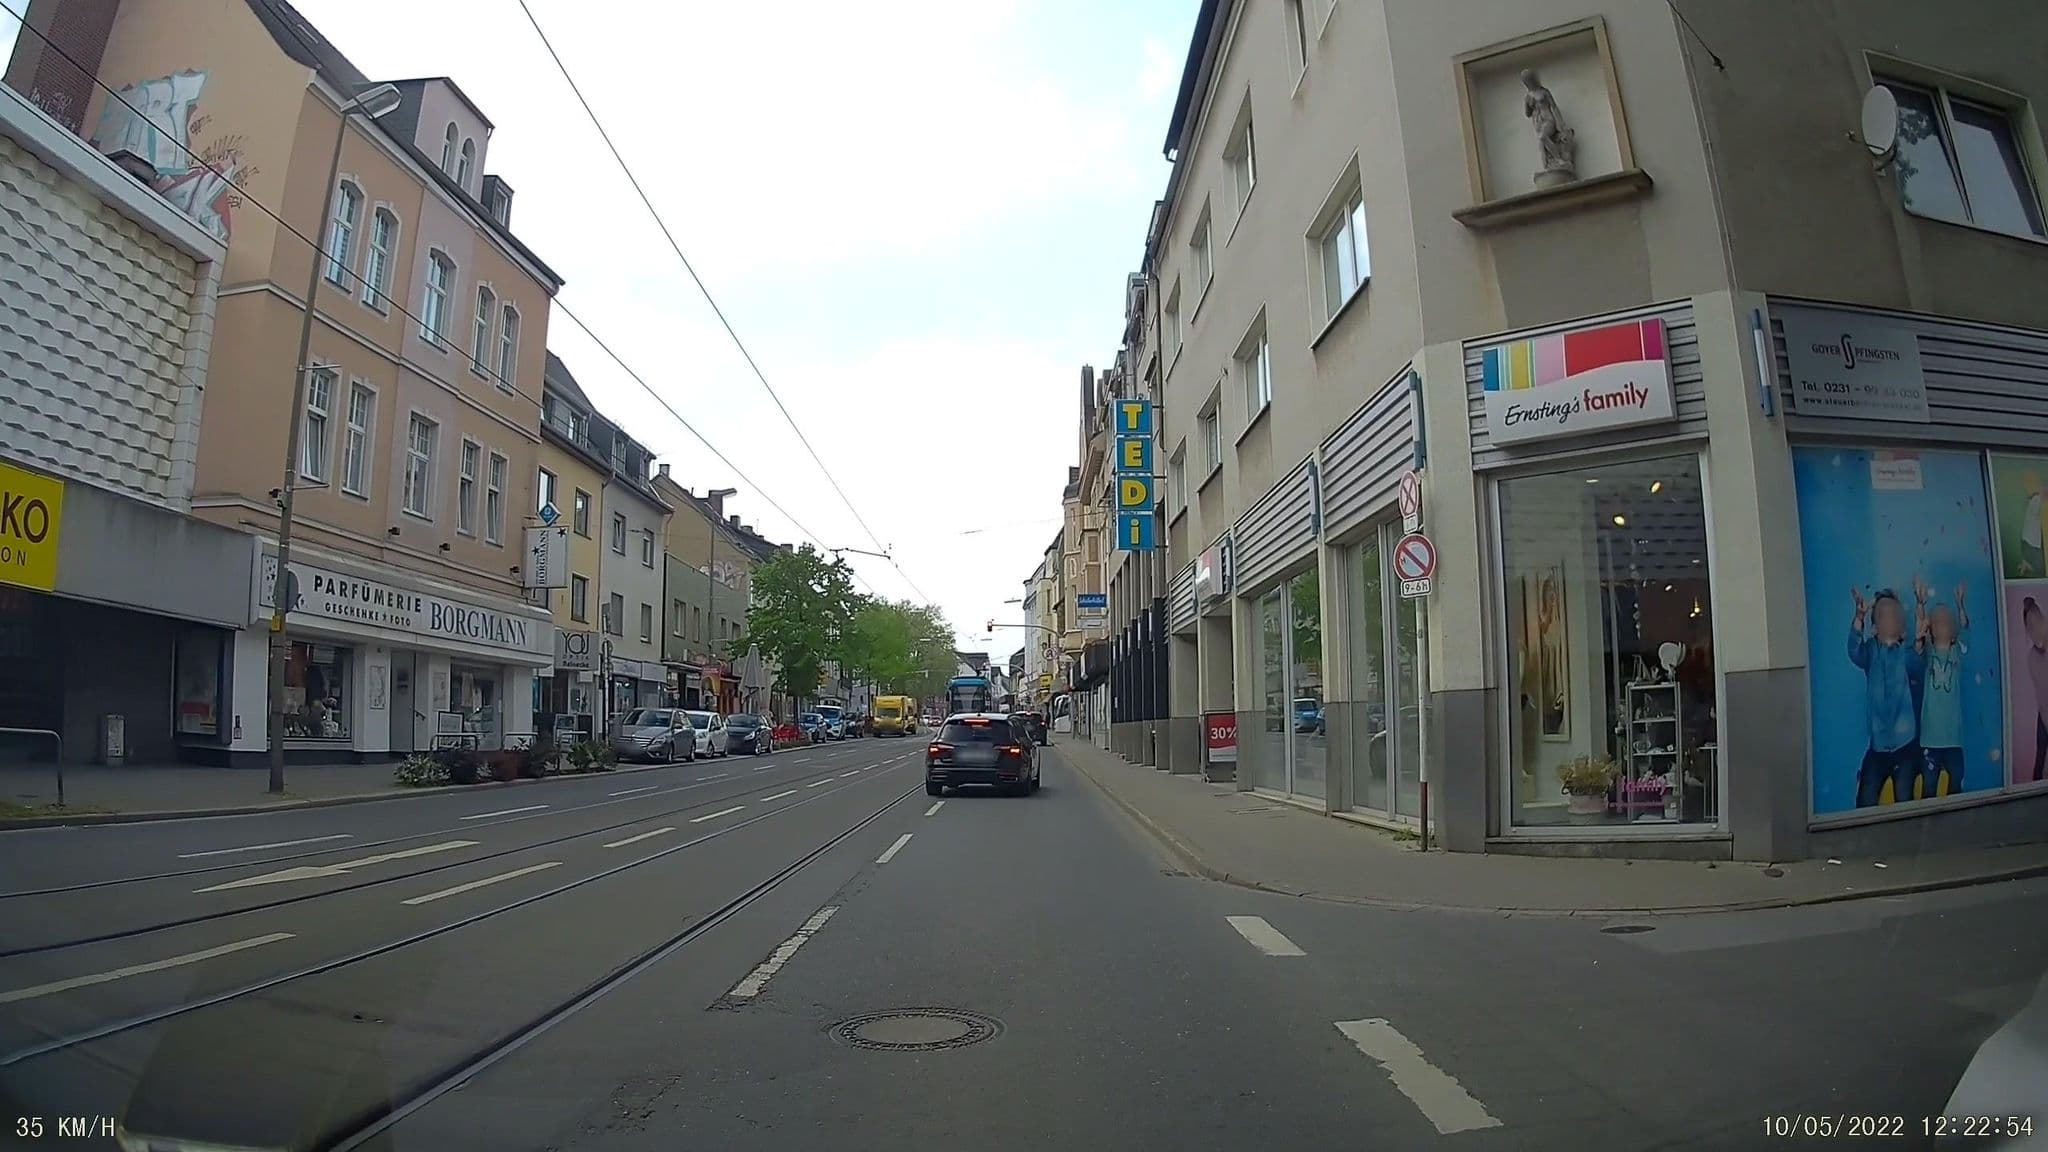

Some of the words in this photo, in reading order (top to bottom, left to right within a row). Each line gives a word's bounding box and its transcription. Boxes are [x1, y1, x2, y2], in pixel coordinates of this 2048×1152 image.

[1504, 396, 1580, 425] Ernsting's
[1583, 381, 1648, 411] family
[1823, 381, 1850, 393] 0231
[1122, 403, 1148, 545] TEDi
[1, 491, 49, 544] KO
[314, 574, 422, 613] PARFÜMERIE
[430, 601, 527, 646] BORGMANN
[325, 602, 379, 621] GESCHENKE
[390, 614, 411, 626] FOTO
[562, 632, 590, 655] YOU
[1211, 726, 1237, 739] 30%
